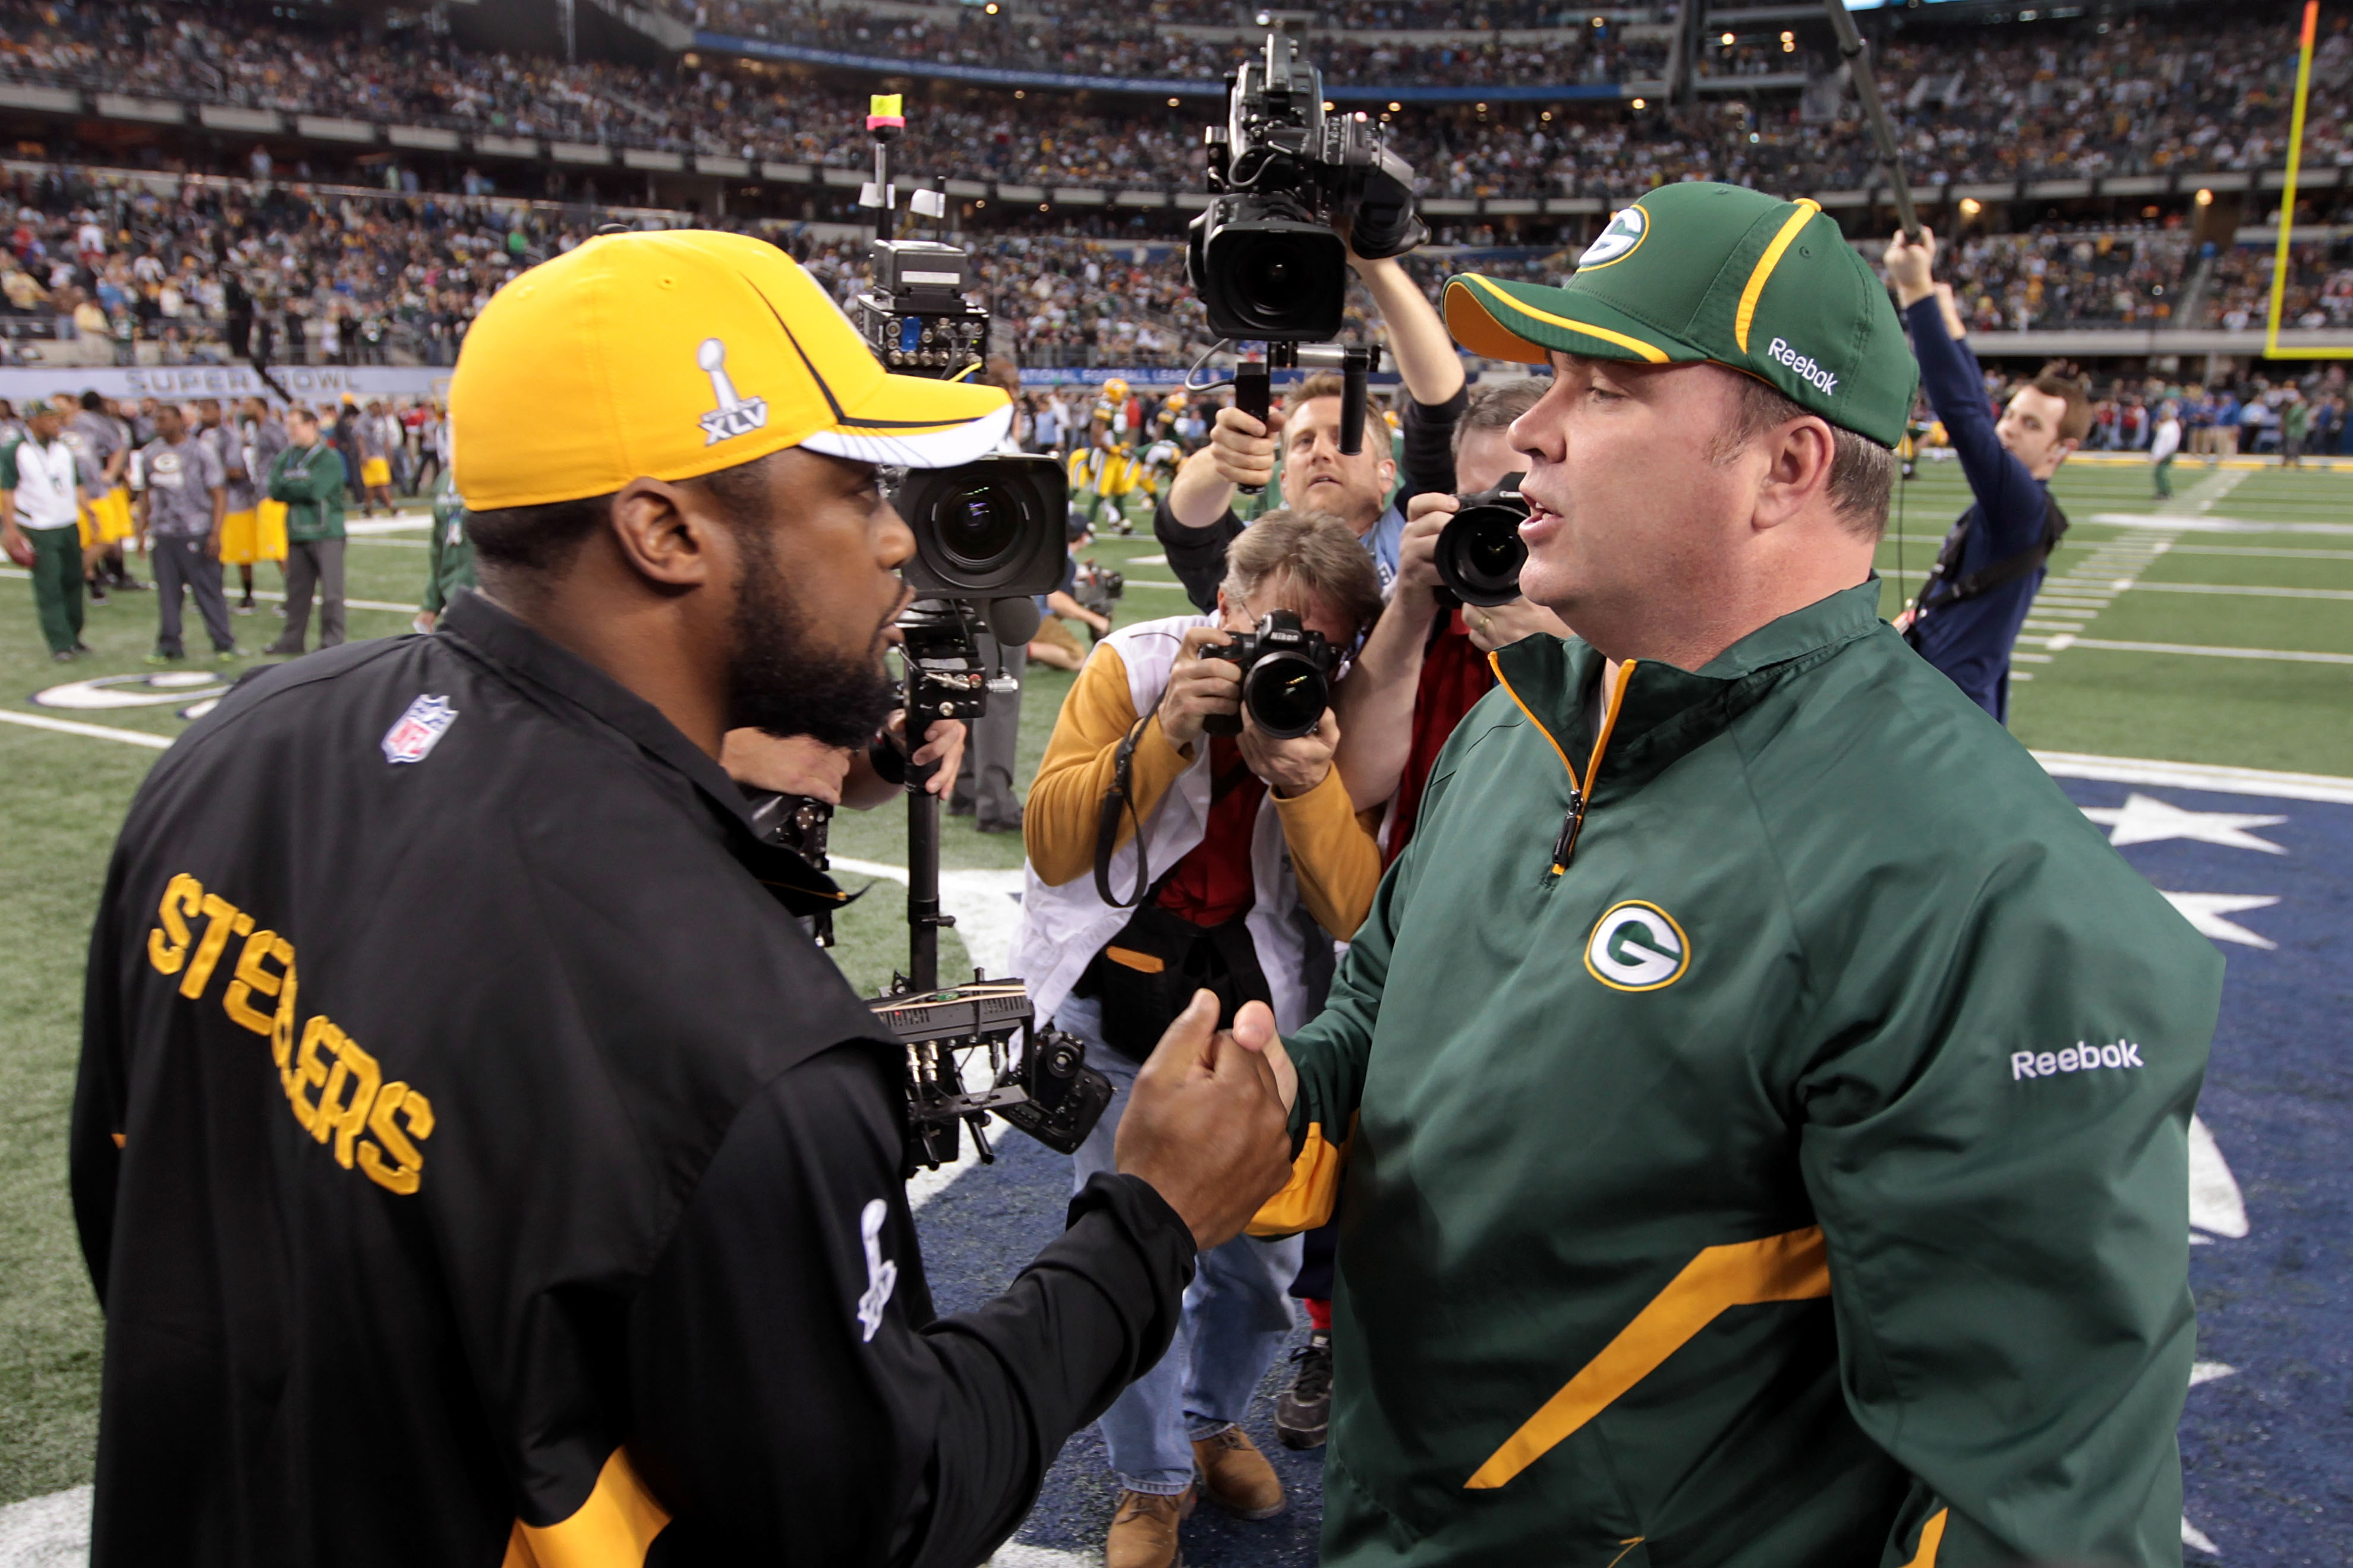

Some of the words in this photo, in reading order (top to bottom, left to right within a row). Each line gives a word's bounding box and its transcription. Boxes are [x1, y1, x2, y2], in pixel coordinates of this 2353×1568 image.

[125, 368, 249, 394] SUPER
[1768, 337, 1838, 396] Reebok
[697, 401, 768, 447] XLV
[1270, 632, 1299, 641] Nikon
[147, 872, 435, 1195] STEERS
[2011, 1038, 2144, 1081] Reebok
